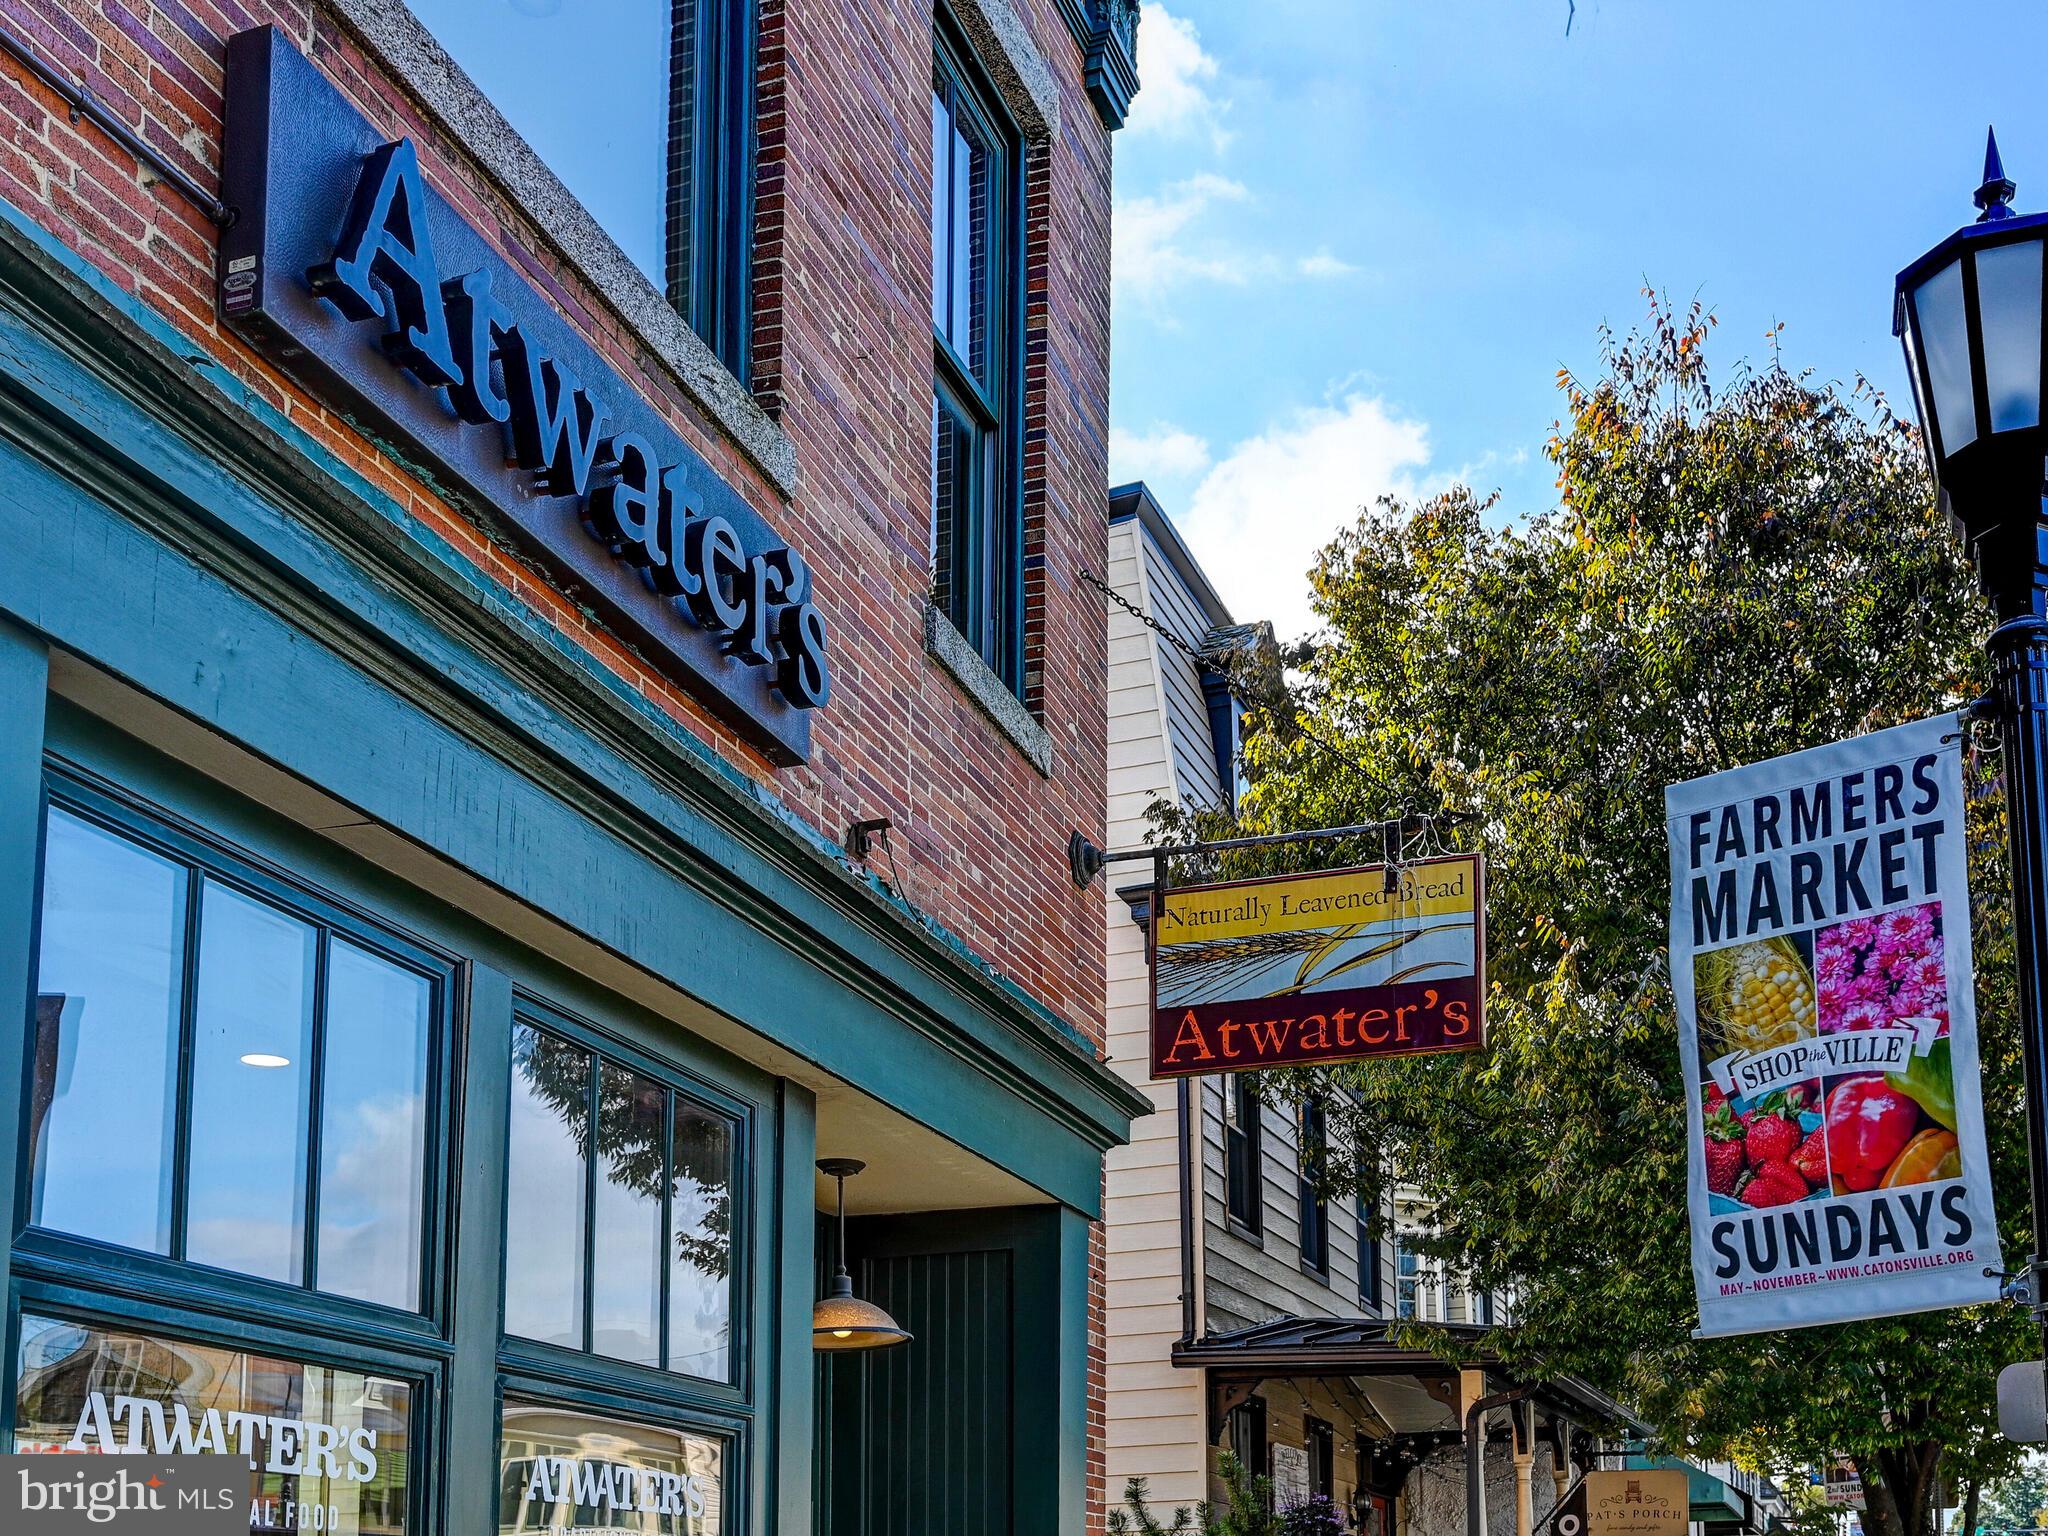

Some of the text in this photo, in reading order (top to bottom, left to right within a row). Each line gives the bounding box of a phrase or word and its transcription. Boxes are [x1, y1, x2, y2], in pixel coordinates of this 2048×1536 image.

[330, 137, 830, 710] Atwater's
[1690, 754, 1940, 870] FARMERS
[1165, 873, 1465, 930] Naturally Leavened Bread
[1692, 820, 1945, 947] MARKET
[1163, 989, 1470, 1064] Atwater's
[1741, 1036, 1904, 1091] SHOP the VILLE
[1711, 1185, 1973, 1279] SUNDAYS
[66, 1391, 378, 1483] ATWATER'S
[285, 1501, 339, 1531] FOOD
[525, 1455, 706, 1518] ATWATER'S
[1633, 1509, 1681, 1520] PORCH
